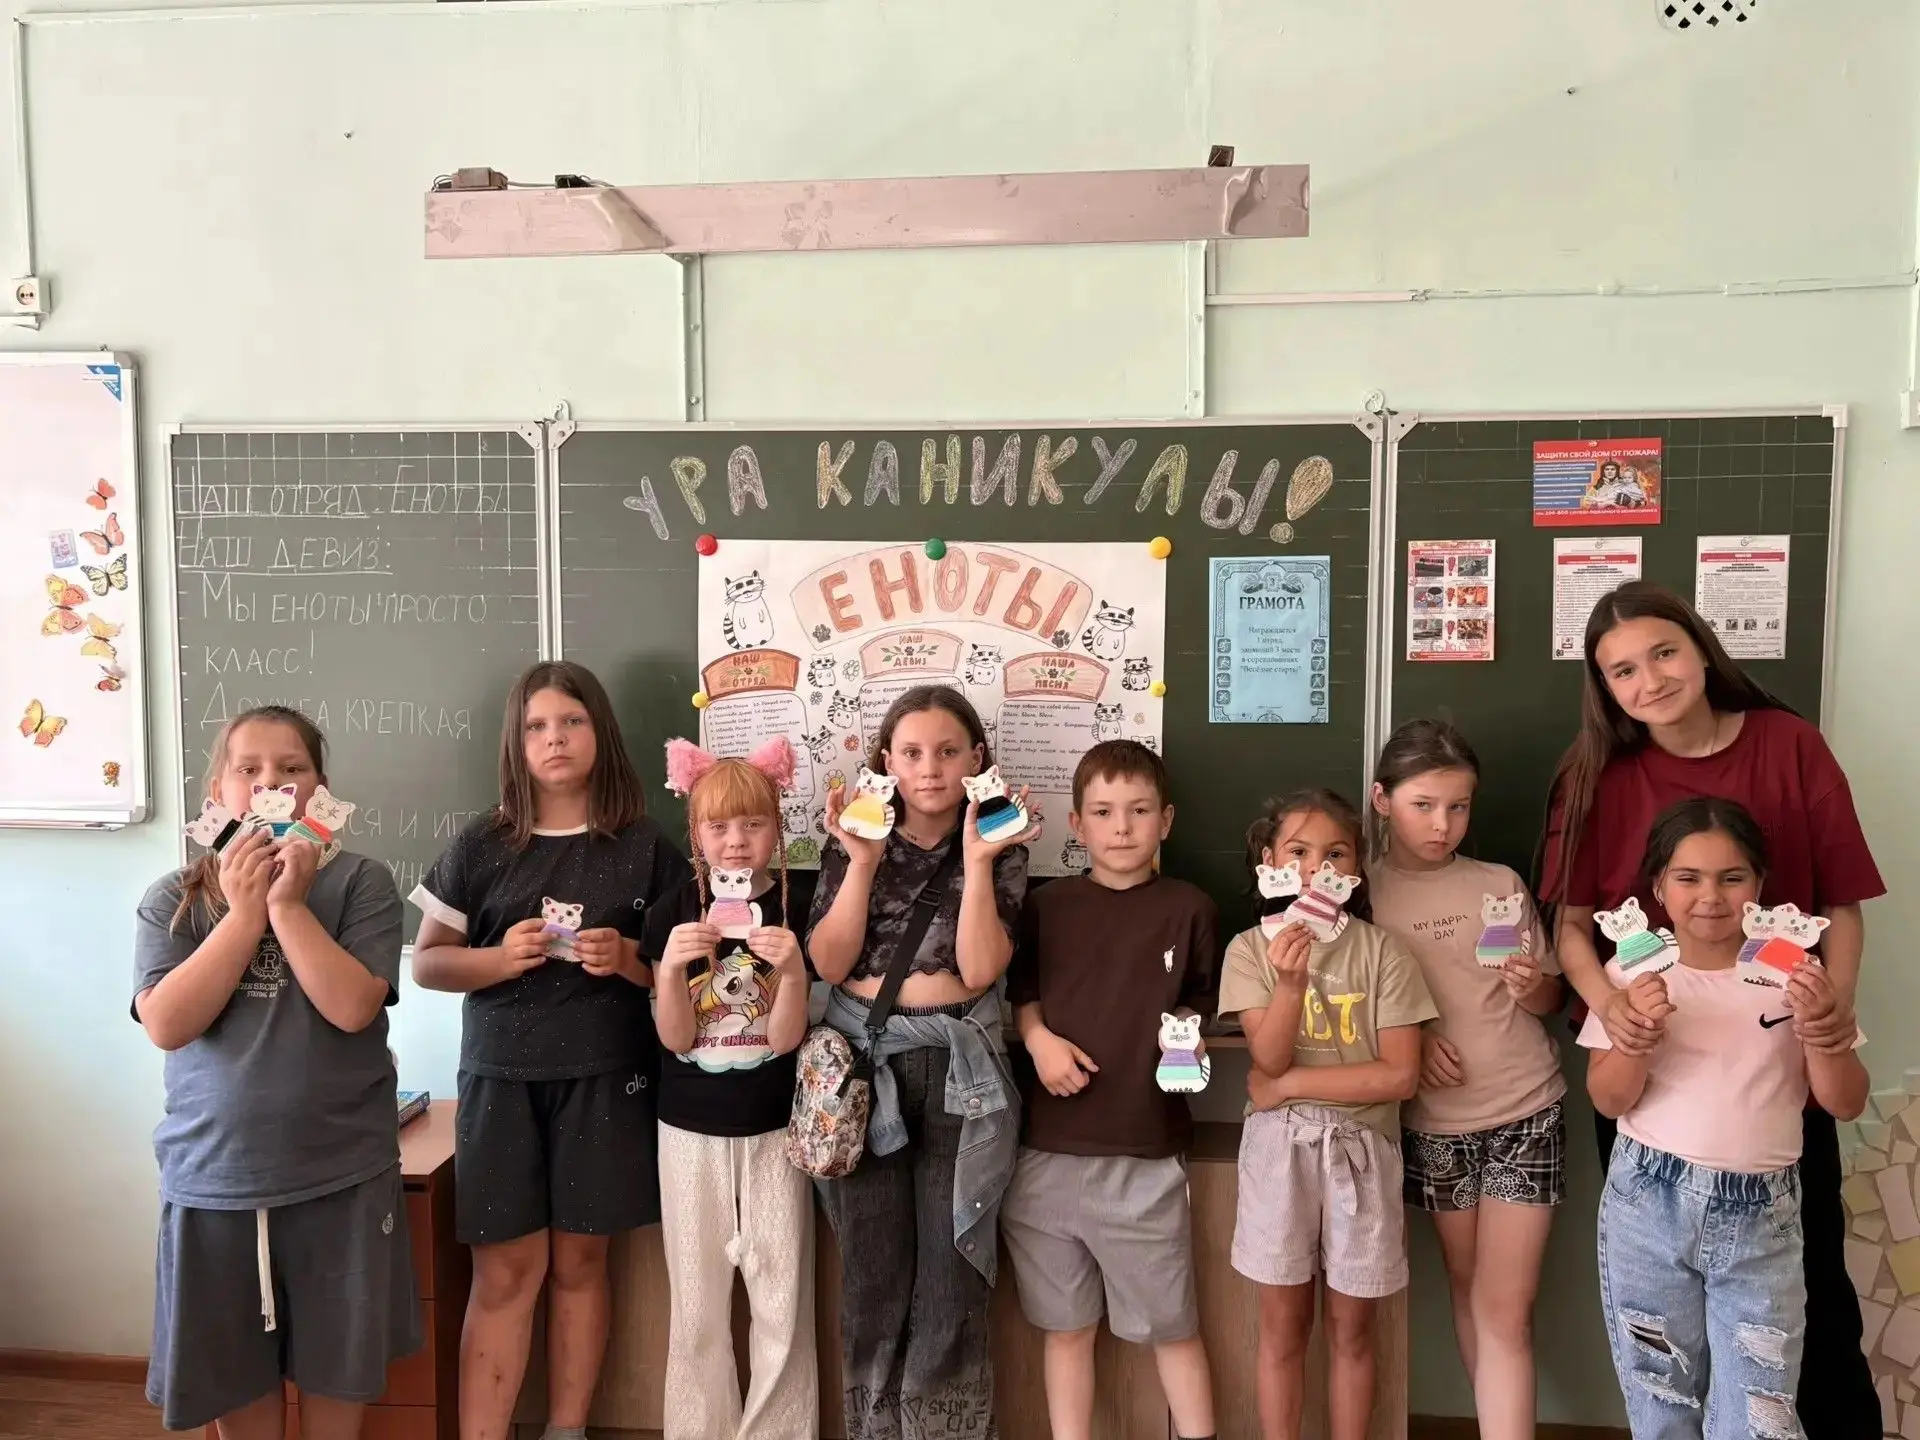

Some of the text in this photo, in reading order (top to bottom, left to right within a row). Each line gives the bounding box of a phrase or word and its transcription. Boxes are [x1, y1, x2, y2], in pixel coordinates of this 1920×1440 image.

[1535, 448, 1659, 460] ЗАЩИТИ СВОЙ ДОМ ОТ ПОЖАРА!
[622, 433, 1334, 544] УРА КАНИКУЛЫ!
[818, 545, 1080, 640] ЕНОТЫ
[1239, 596, 1305, 610] ГРАМОТА
[898, 634, 924, 646] НАШ
[732, 652, 761, 667] НАШ
[892, 656, 928, 668] ДЕВИЗ
[1040, 657, 1076, 669] НАША
[732, 677, 769, 688] ОТРЯД
[1034, 679, 1070, 691] ПЕСНЯ
[345, 697, 473, 742] КРЕПКАЯ
[399, 807, 418, 839] И
[1413, 921, 1429, 931] MY
[1434, 929, 1455, 940] DAY
[263, 952, 279, 970] R
[720, 1034, 770, 1047] UNICOR
[625, 1072, 648, 1096] alo
